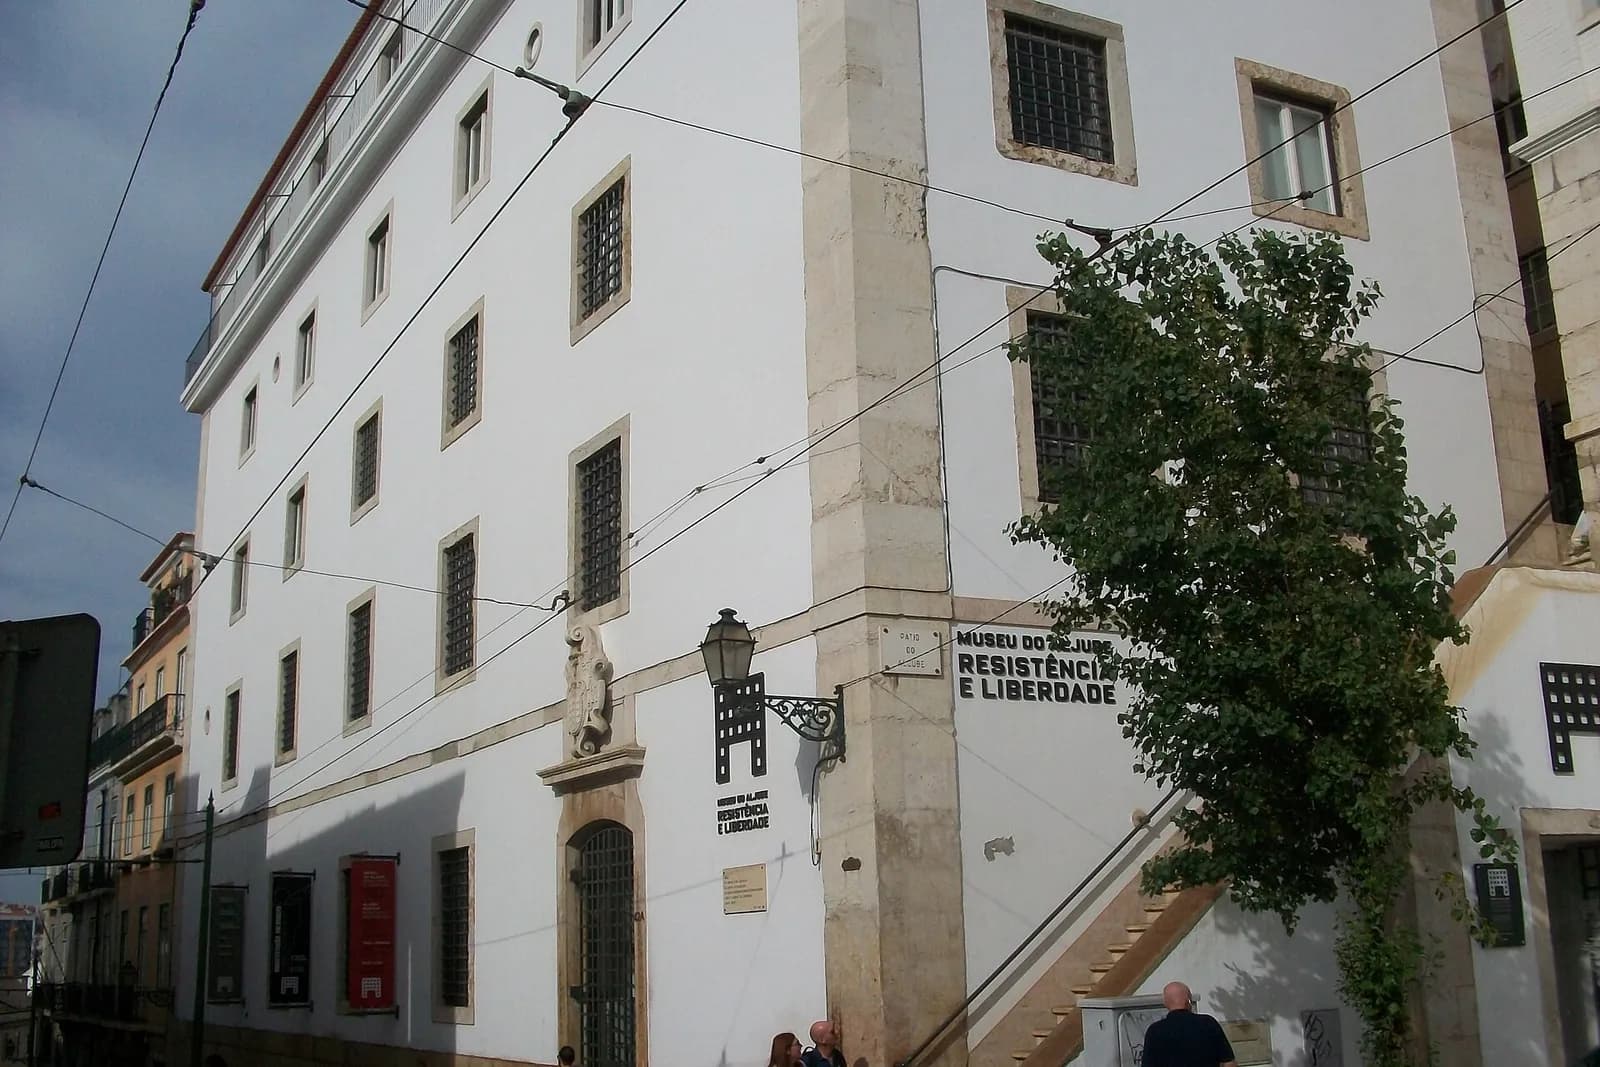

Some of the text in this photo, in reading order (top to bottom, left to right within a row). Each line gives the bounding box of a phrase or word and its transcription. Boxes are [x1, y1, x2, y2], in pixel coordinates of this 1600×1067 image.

[957, 631, 1017, 650] MUSEU
[1022, 635, 1046, 651] DO
[960, 677, 1117, 704] E LIBERDADE
[718, 823, 723, 835] E
